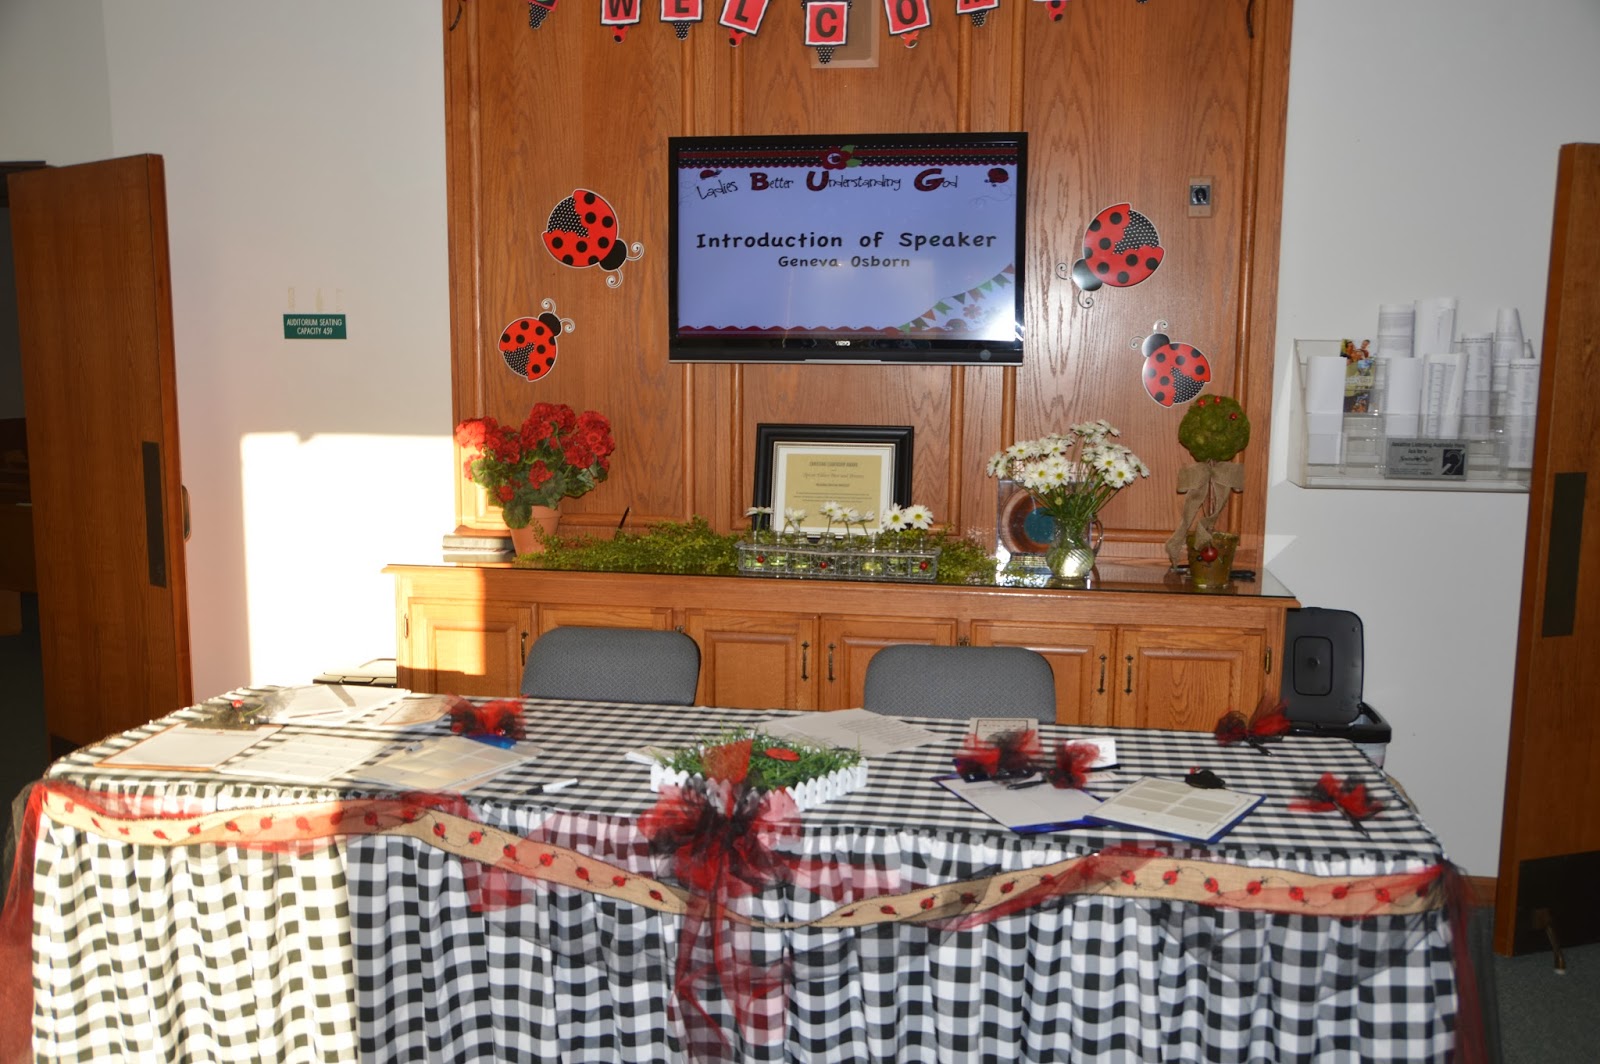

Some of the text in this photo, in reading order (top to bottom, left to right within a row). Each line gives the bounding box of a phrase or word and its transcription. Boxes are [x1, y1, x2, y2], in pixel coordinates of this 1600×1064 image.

[696, 168, 958, 200] Ladies Better Understanding God
[696, 231, 997, 251] Introduction of Speaker
[778, 255, 910, 268] Geneva Osborn
